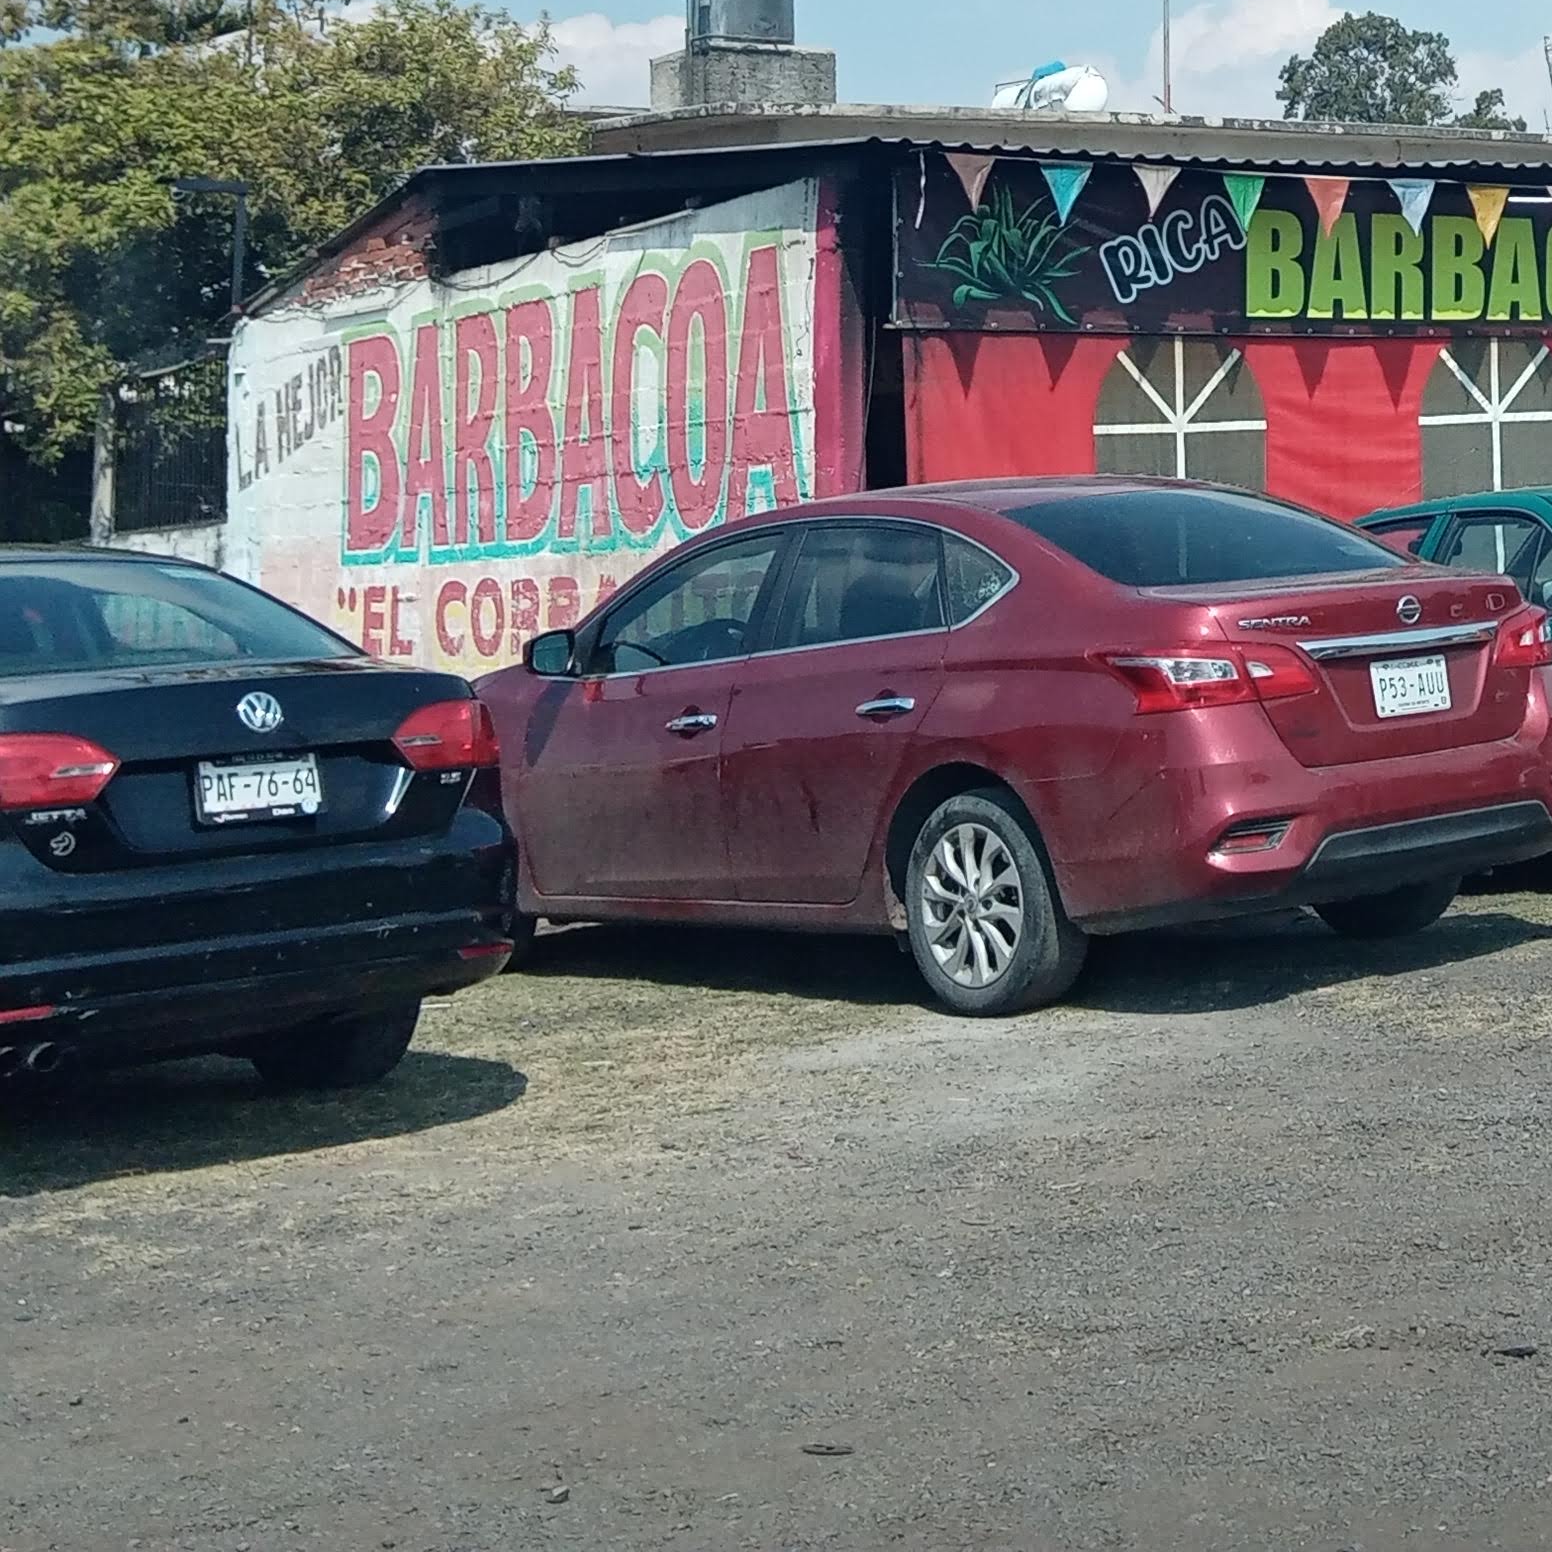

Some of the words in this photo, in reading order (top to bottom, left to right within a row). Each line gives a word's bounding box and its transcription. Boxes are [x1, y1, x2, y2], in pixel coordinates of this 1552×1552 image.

[1100, 194, 1247, 305] RICA
[235, 400, 269, 492] LA
[343, 243, 803, 558] BARBACOA
[1237, 615, 1313, 631] SENTRA
[1379, 671, 1445, 702] P53-AUU
[200, 767, 317, 803] PAF-76-64
